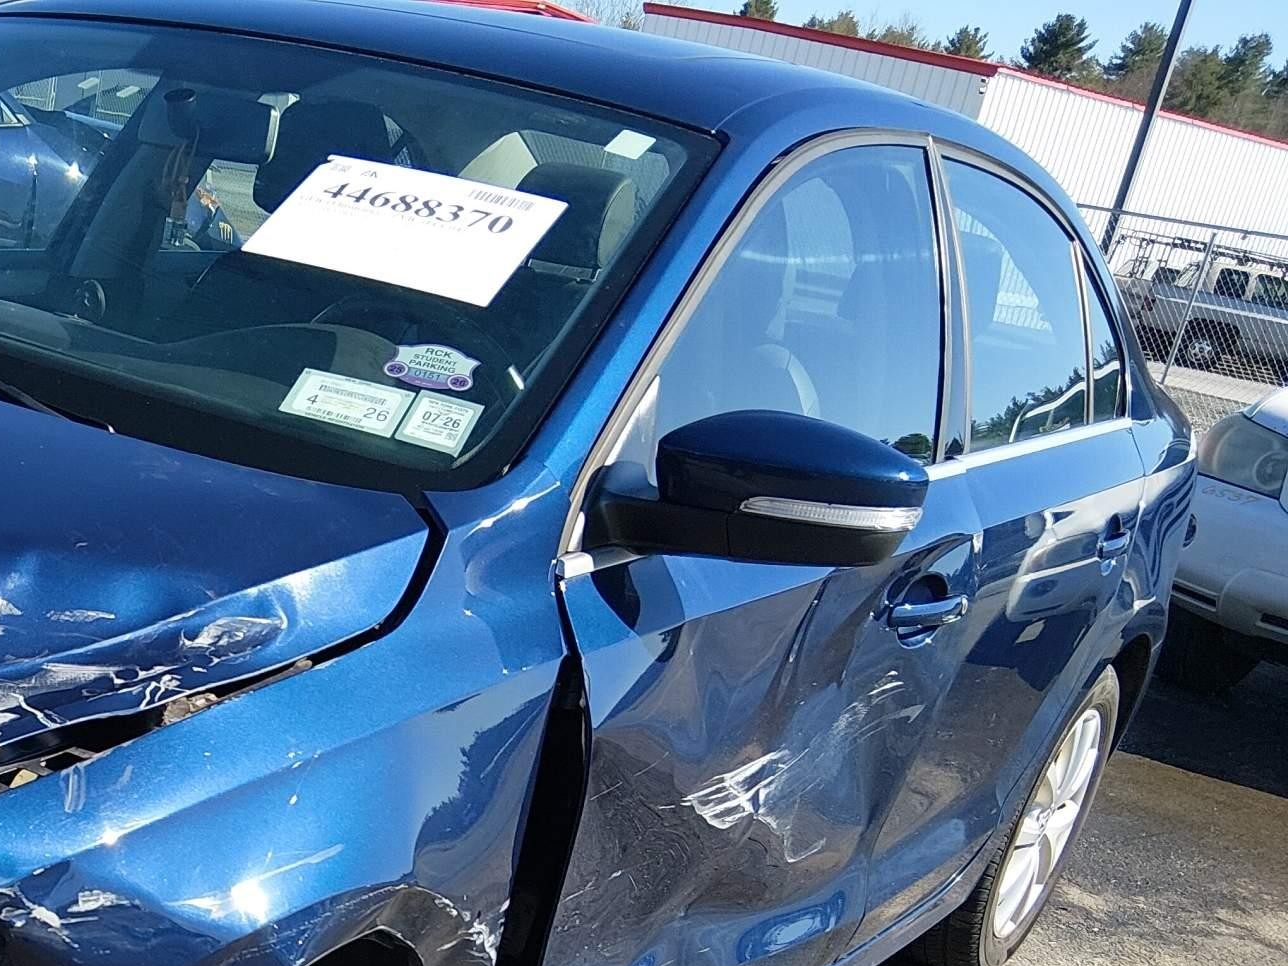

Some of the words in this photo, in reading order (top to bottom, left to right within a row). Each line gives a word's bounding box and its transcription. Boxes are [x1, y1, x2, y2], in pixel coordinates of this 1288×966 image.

[323, 182, 514, 234] 44688370
[413, 353, 458, 367] STUDENT
[425, 347, 453, 359] RCK
[408, 359, 456, 374] PARKING
[306, 394, 319, 405] 4
[363, 407, 390, 422] 26
